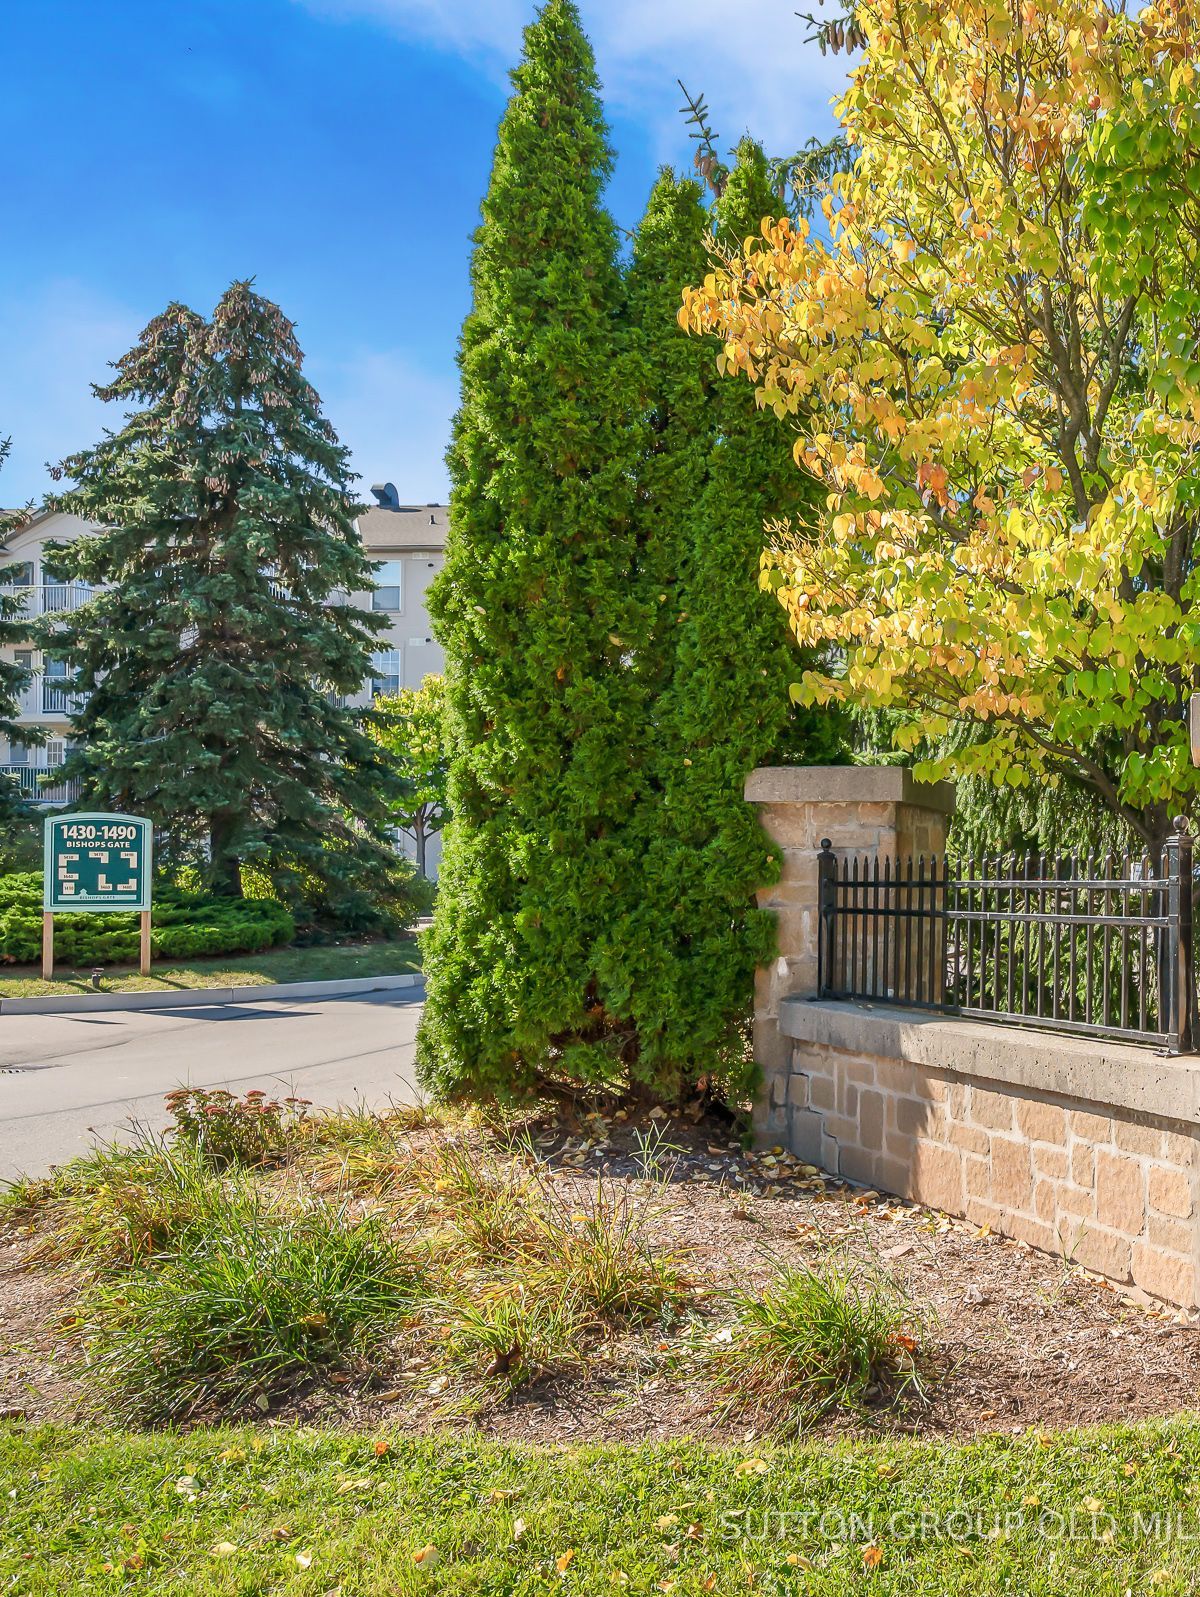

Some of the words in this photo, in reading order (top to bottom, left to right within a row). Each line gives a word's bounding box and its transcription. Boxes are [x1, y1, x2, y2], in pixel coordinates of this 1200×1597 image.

[60, 824, 137, 840] 1430-1490
[66, 840, 106, 849] BISHOPS
[107, 841, 131, 849] GATE
